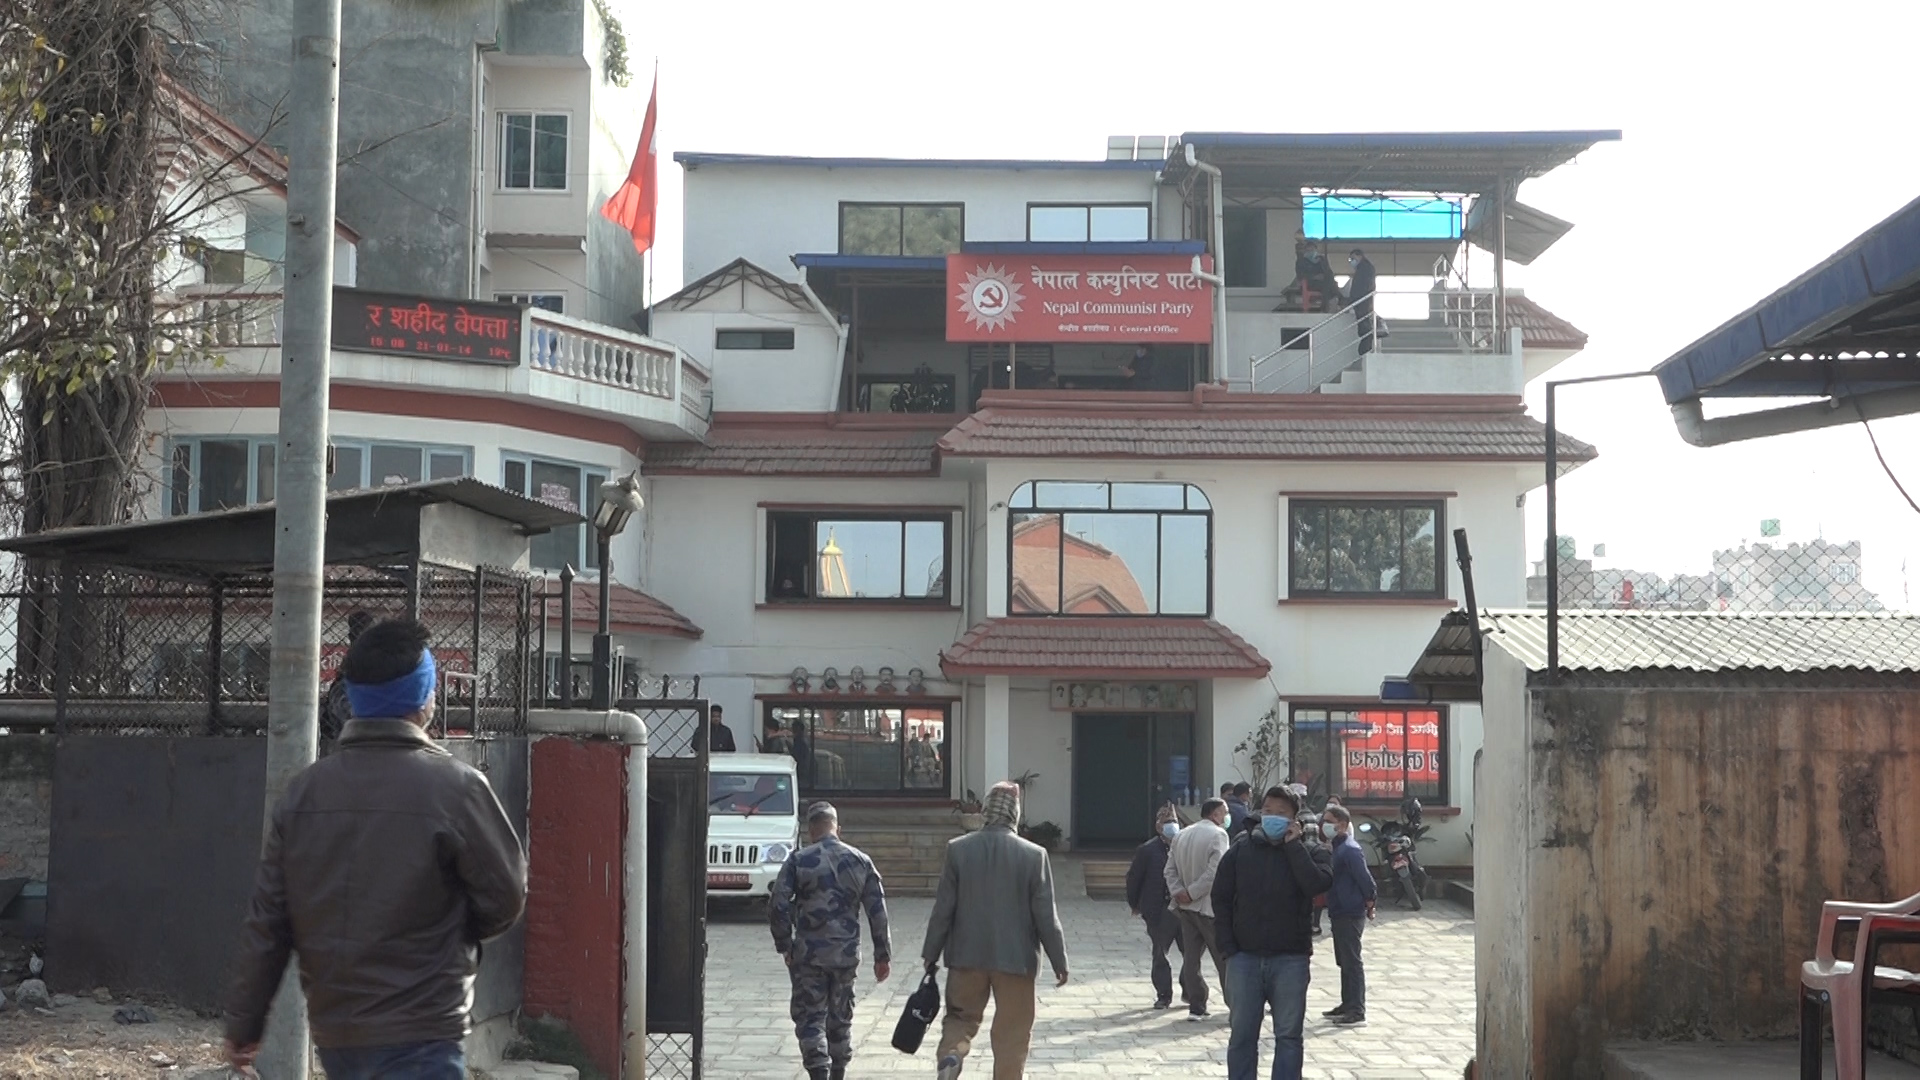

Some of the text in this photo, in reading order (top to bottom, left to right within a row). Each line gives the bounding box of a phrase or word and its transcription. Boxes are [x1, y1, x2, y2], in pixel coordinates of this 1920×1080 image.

[1030, 265, 1080, 290] नेपाल
[1086, 265, 1159, 296] कम्युनिष्ट
[389, 302, 447, 335] शहीद
[1043, 301, 1194, 318] Nepal Communist Party
[1119, 325, 1152, 334] Central
[1153, 325, 1179, 334] Office
